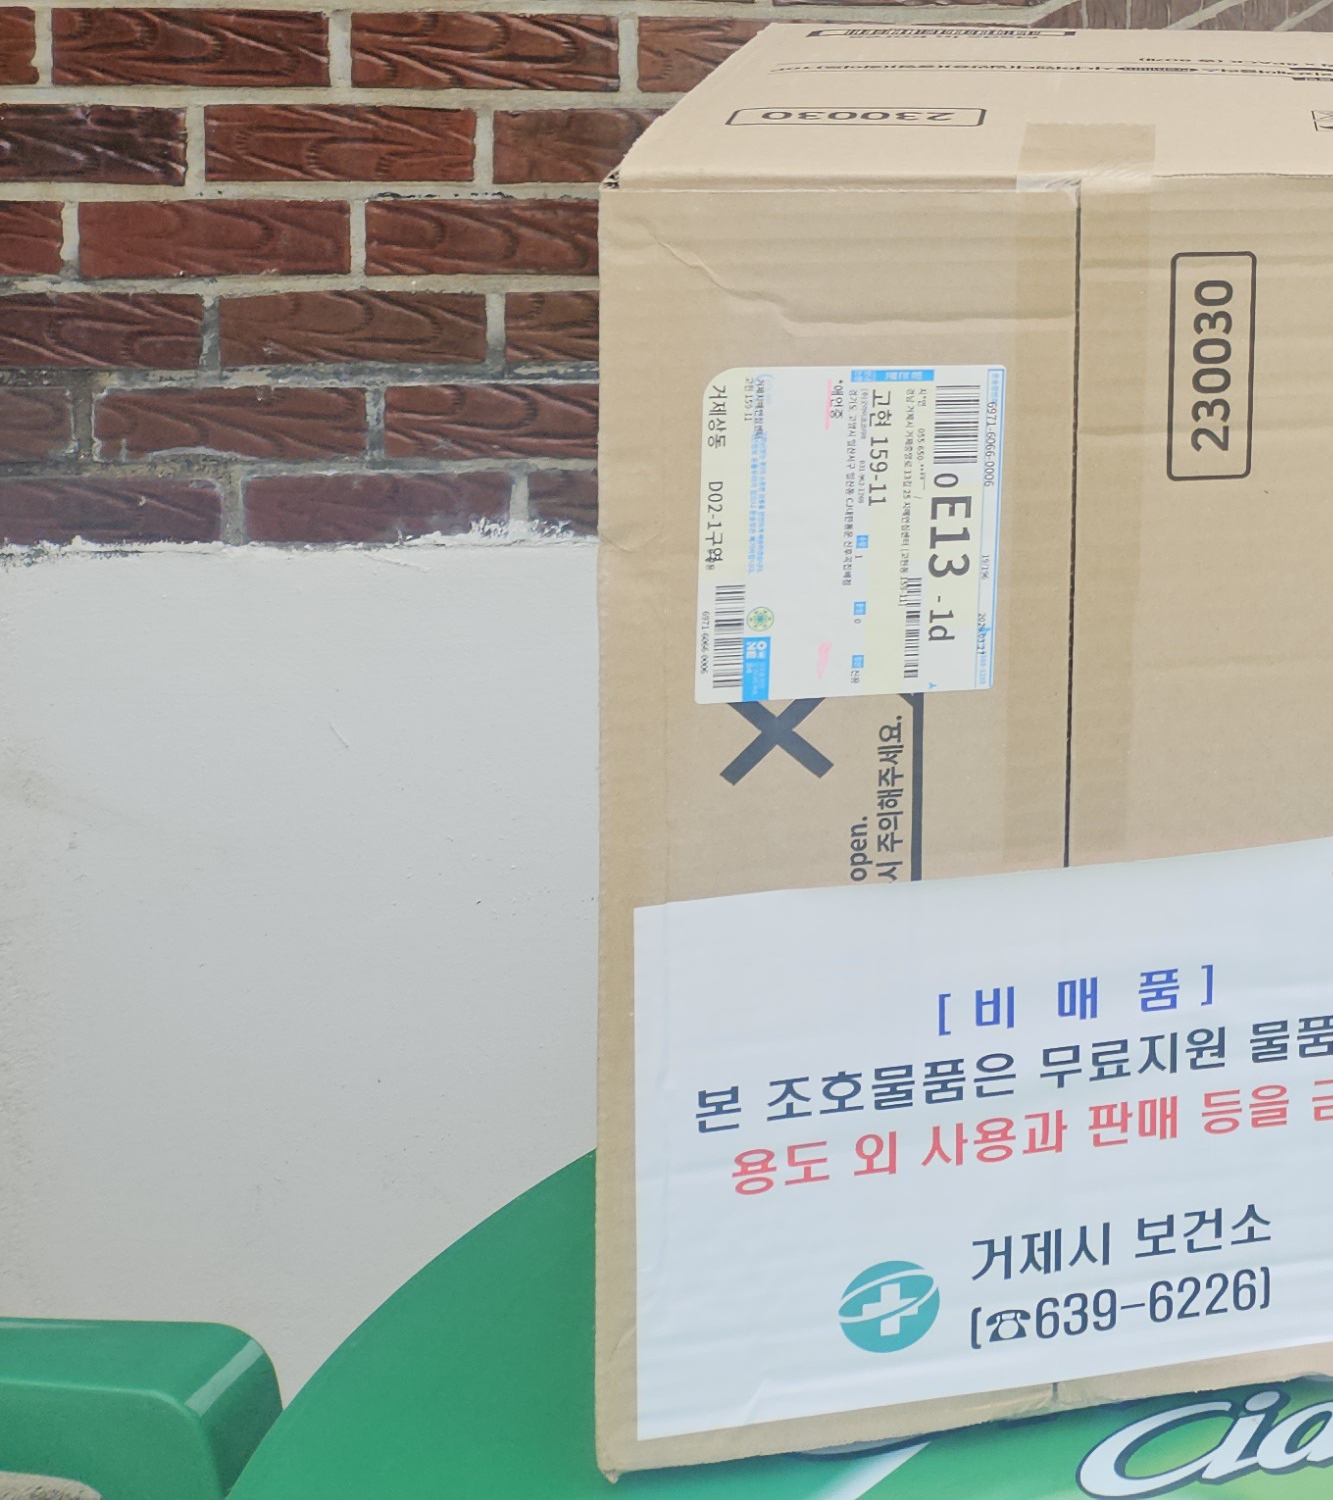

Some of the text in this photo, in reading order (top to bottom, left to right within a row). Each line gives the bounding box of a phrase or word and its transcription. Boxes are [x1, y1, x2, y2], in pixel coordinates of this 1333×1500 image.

[761, 111, 955, 122] 230030
[1191, 280, 1233, 451] 230030
[708, 385, 727, 449] 거제상동
[868, 389, 892, 506] 고현 159-11
[905, 406, 914, 428] 거제시
[877, 712, 904, 853] 주의해주세요.
[850, 816, 873, 882] open.
[696, 1086, 741, 1133] 본
[767, 1053, 1016, 1121] 조호물품은
[1040, 1027, 1225, 1088] 무료지원
[732, 1141, 829, 1195] 용도
[854, 1131, 896, 1175] 외
[922, 1110, 1067, 1166] 사용과
[1089, 1096, 1177, 1147] 판매
[1202, 1085, 1289, 1134] 등을
[972, 1204, 1271, 1280] 거제시 보건소
